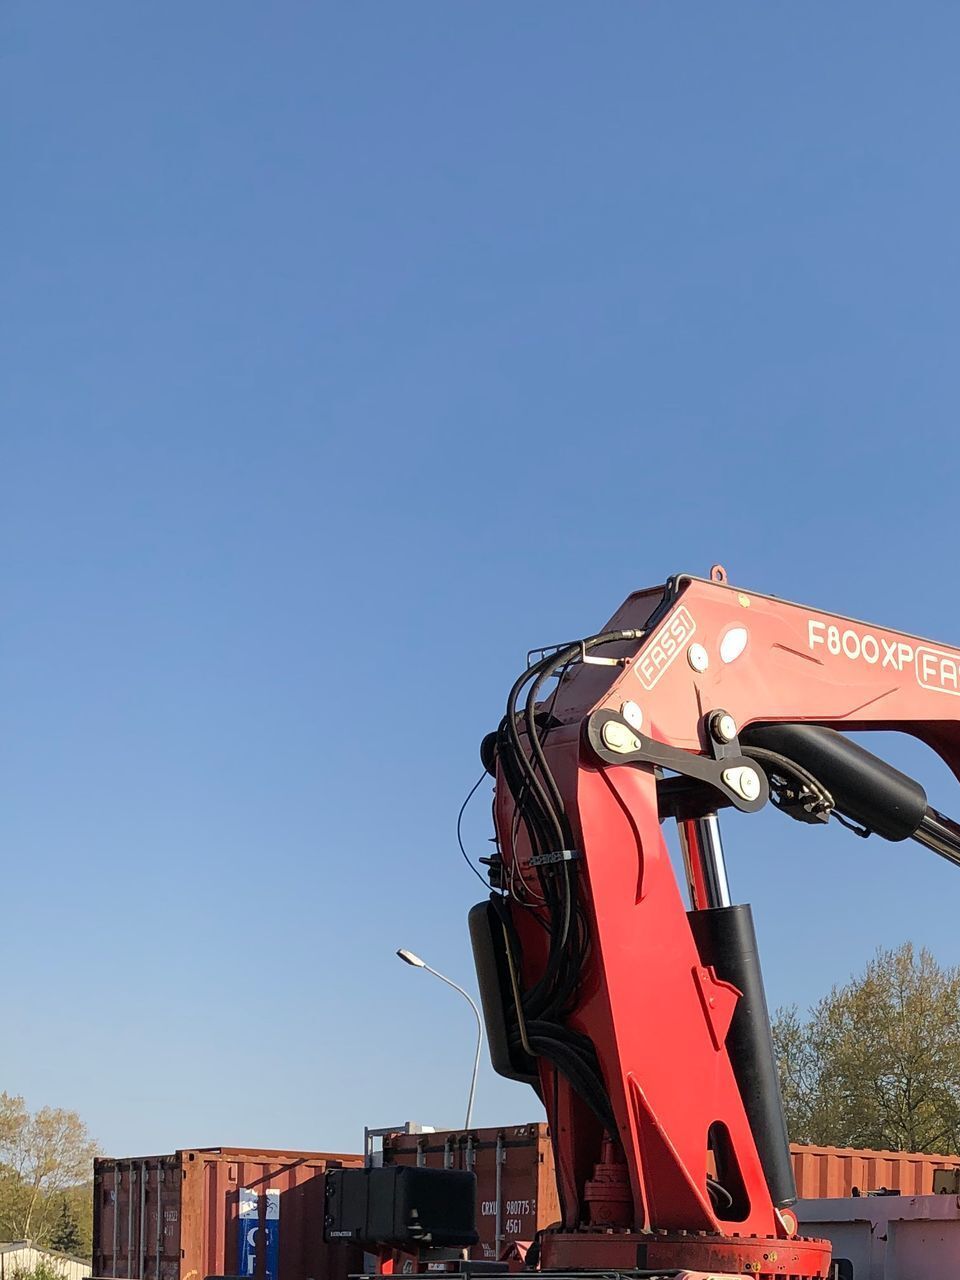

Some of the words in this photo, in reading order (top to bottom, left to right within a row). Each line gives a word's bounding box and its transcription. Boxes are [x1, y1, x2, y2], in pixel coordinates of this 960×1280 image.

[640, 614, 691, 682] FASSI
[808, 619, 914, 671] F800XP
[506, 1200, 530, 1215] 980775
